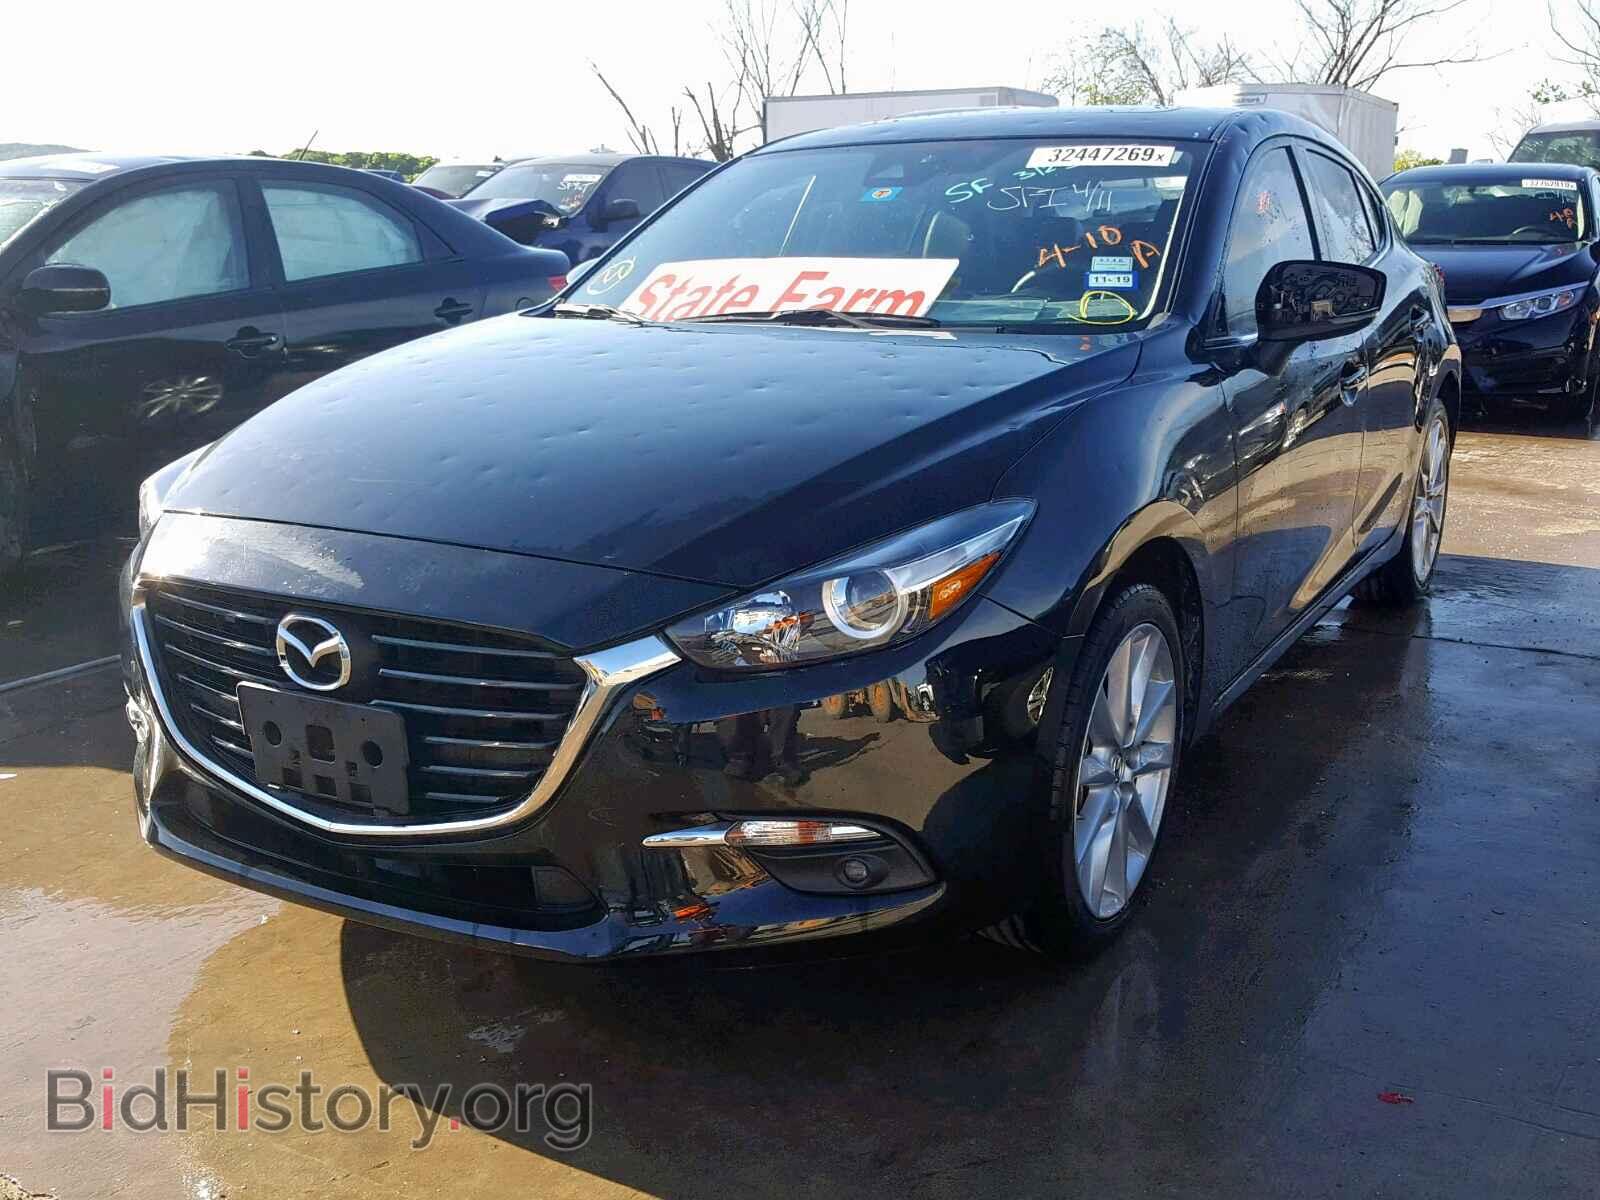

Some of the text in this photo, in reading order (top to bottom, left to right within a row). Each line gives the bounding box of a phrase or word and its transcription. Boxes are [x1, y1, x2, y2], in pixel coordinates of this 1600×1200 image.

[944, 177, 994, 204] SF
[1092, 274, 1132, 285] 11-19
[637, 273, 760, 322] State
[771, 271, 927, 318] Farm
